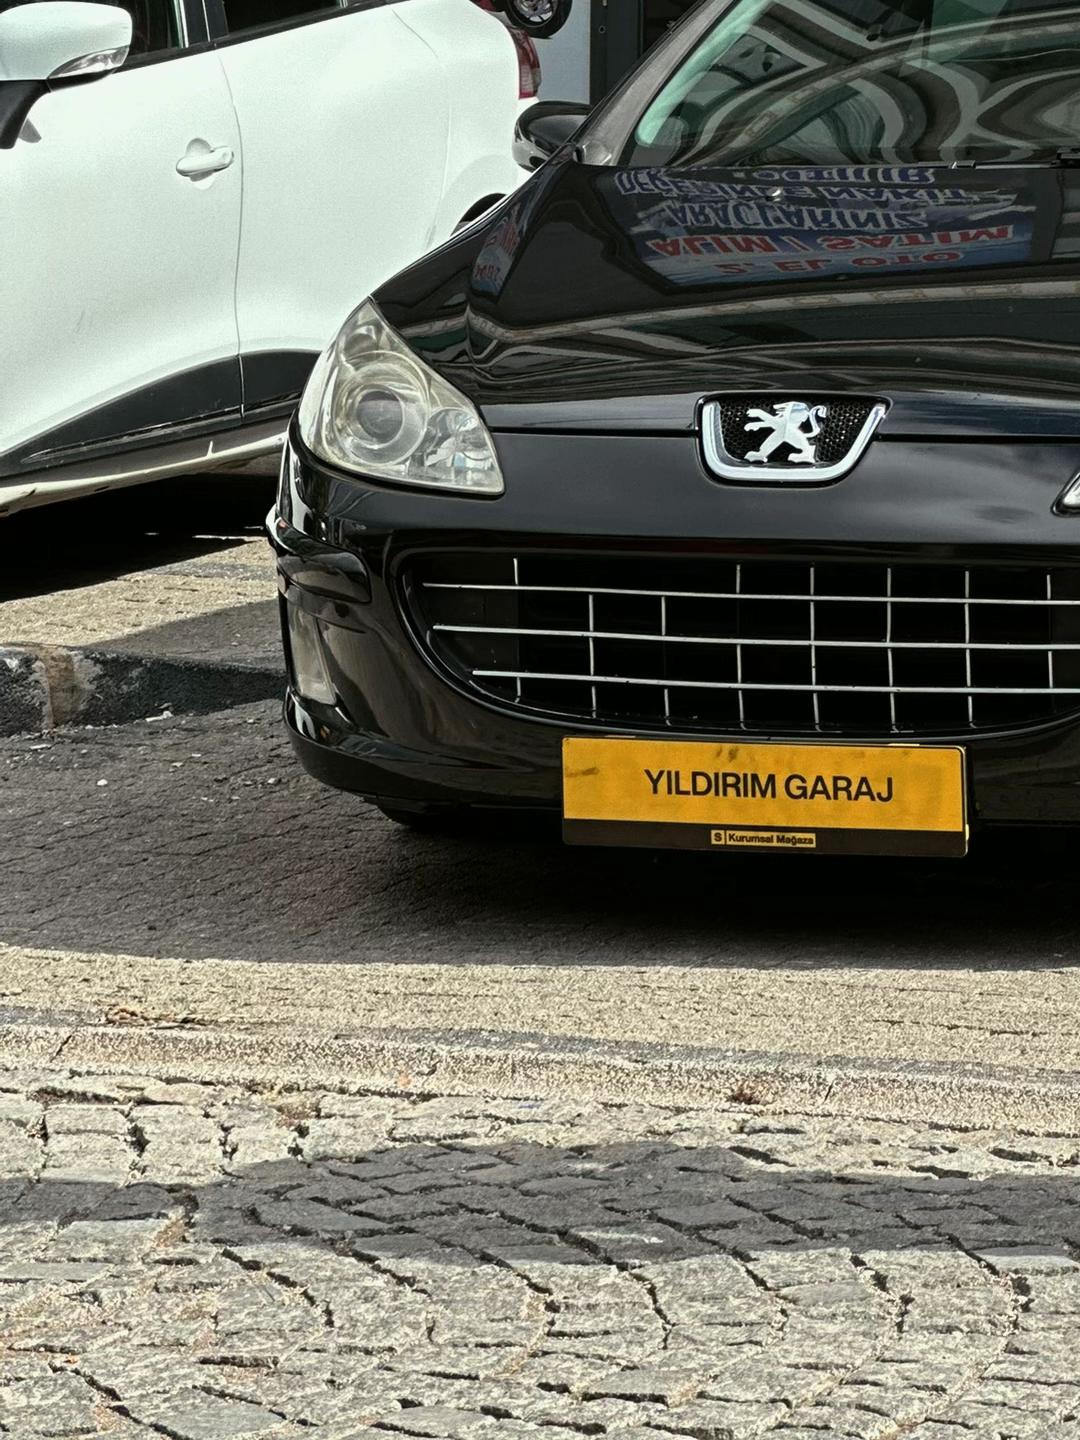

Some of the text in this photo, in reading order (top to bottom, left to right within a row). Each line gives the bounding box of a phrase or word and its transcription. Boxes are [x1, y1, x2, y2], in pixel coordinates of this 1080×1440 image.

[643, 768, 894, 803] YILDIRIM GARAJ
[713, 832, 815, 847] S Kurumsal Mağaza
